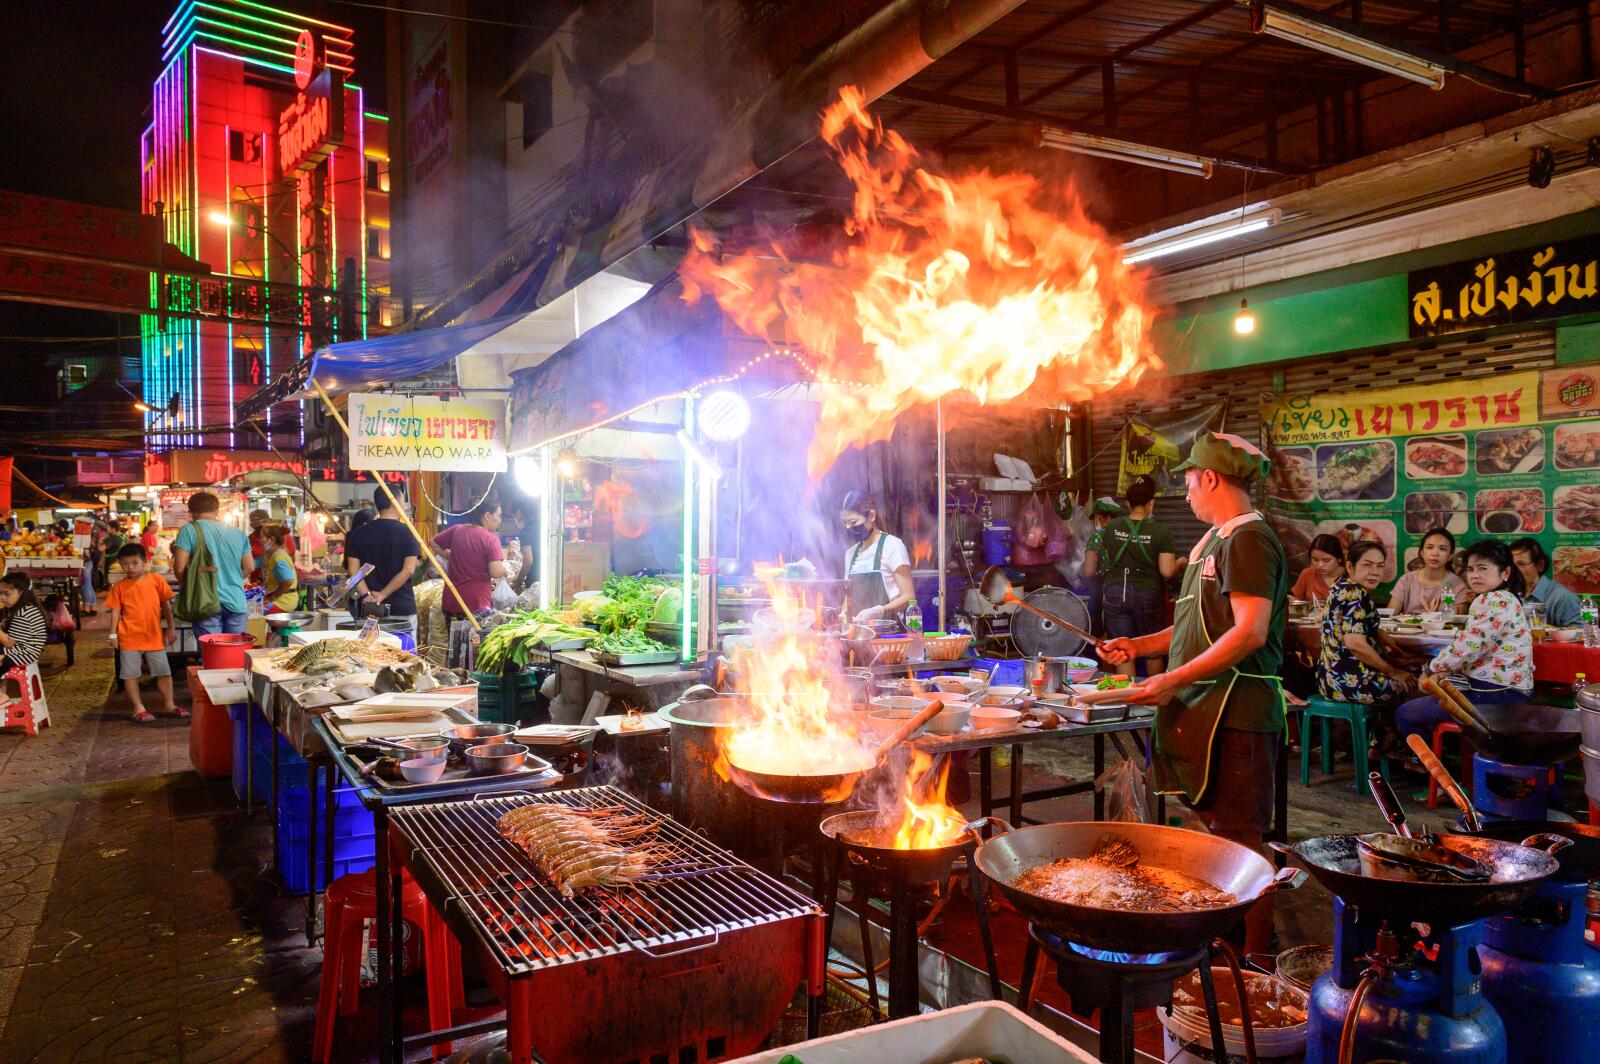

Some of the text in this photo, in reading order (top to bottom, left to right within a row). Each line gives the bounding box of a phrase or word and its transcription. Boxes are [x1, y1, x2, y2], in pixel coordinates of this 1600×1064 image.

[356, 403, 423, 439] ไฟเขียว
[356, 444, 409, 458] FIKEAW
[413, 445, 445, 459] YAO
